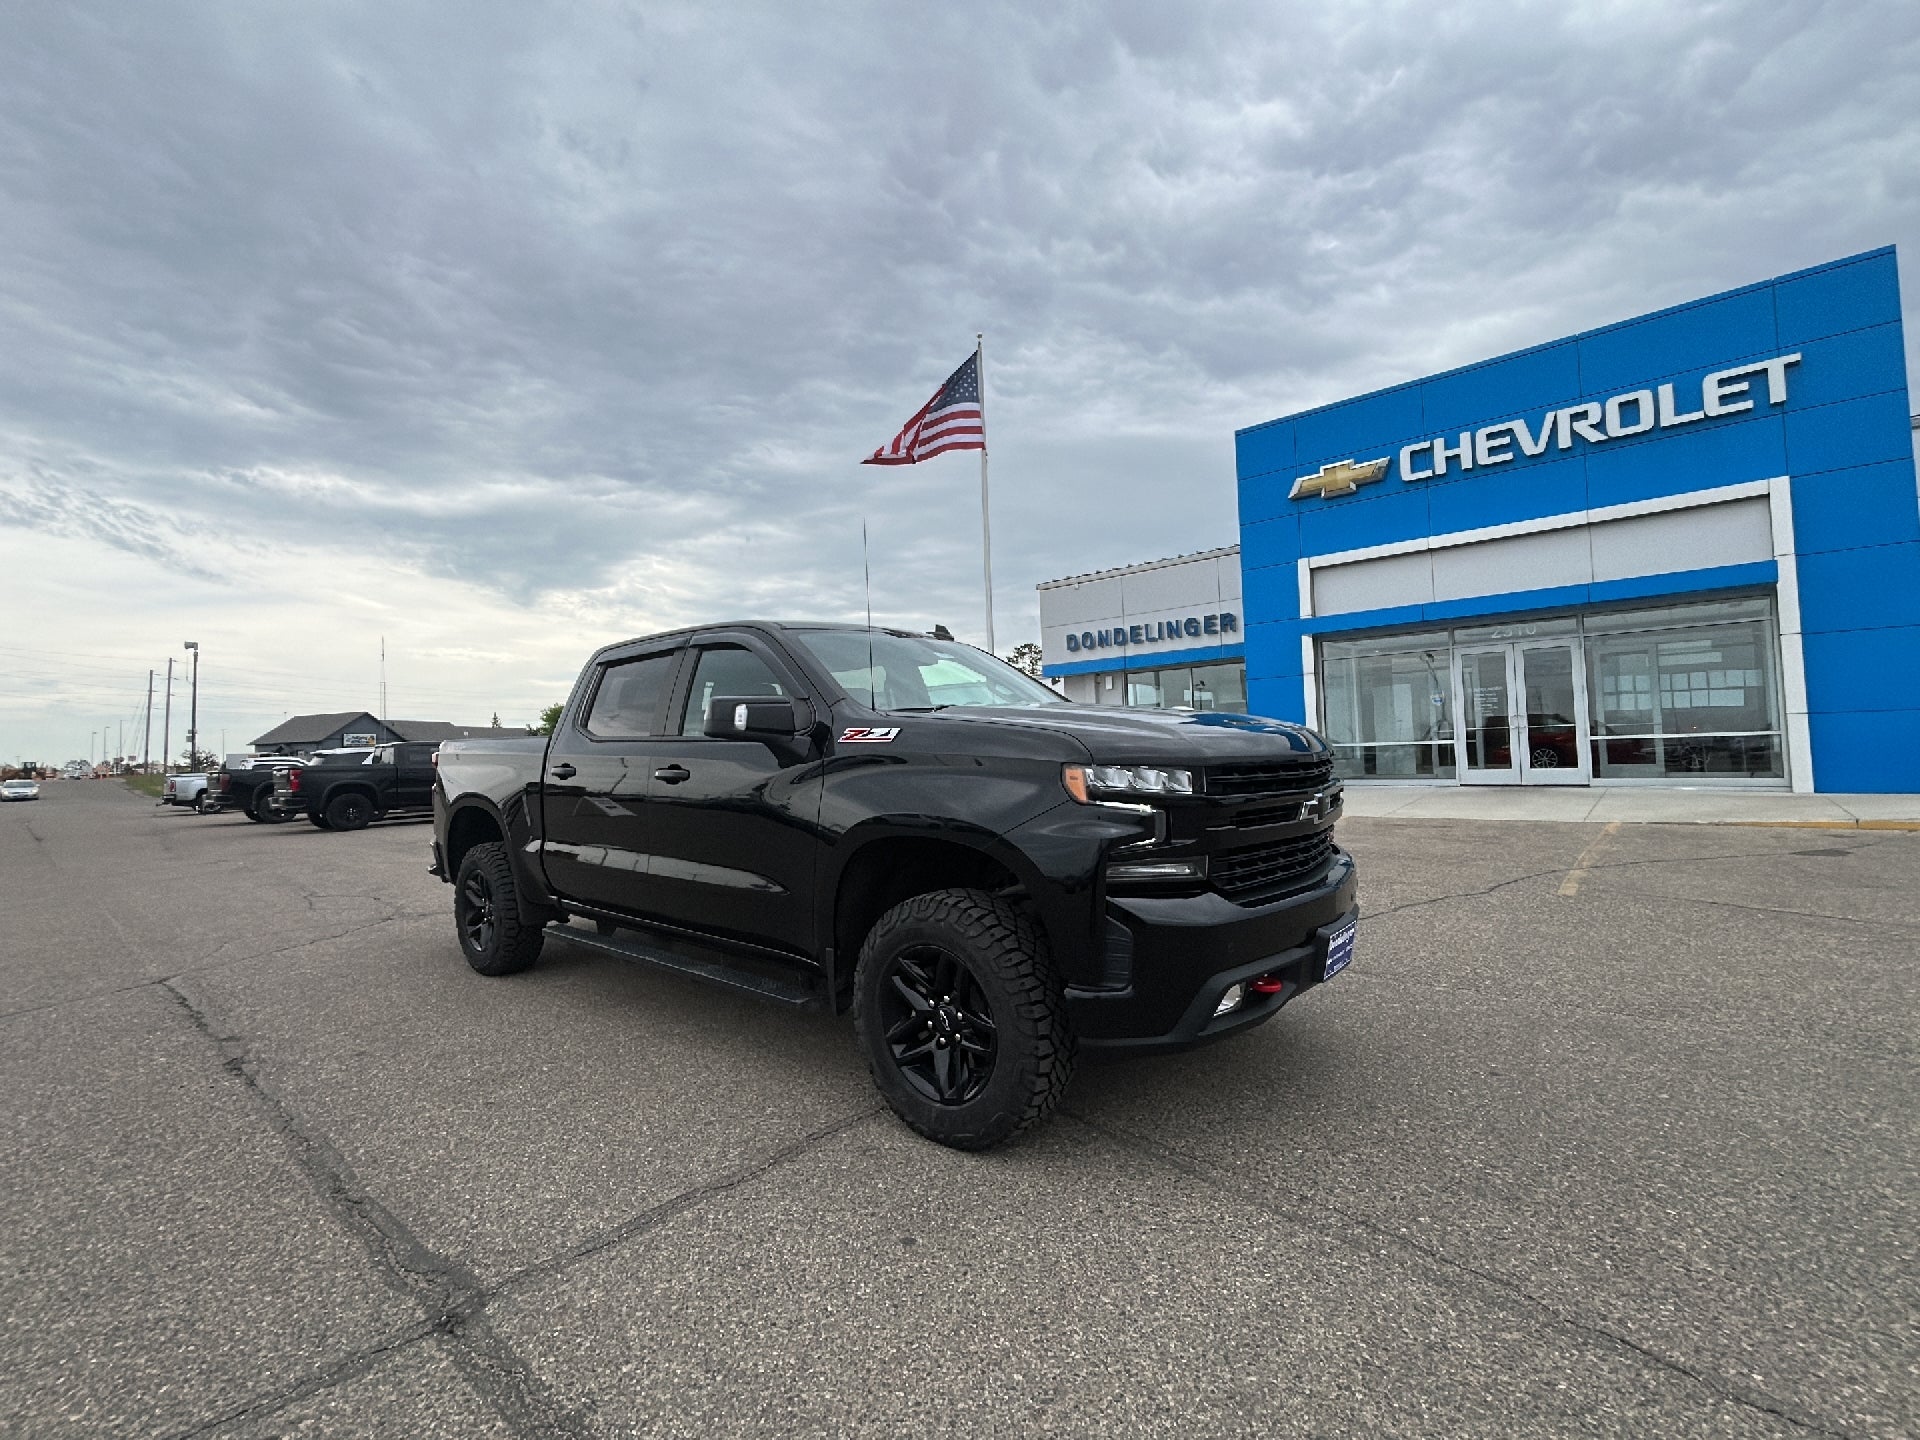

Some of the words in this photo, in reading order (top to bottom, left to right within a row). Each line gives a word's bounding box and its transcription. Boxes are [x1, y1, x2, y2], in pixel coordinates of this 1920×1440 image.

[1400, 352, 1801, 481] CHEVROLET
[1066, 612, 1237, 651] DONDELINGER
[838, 728, 901, 743] Z71
